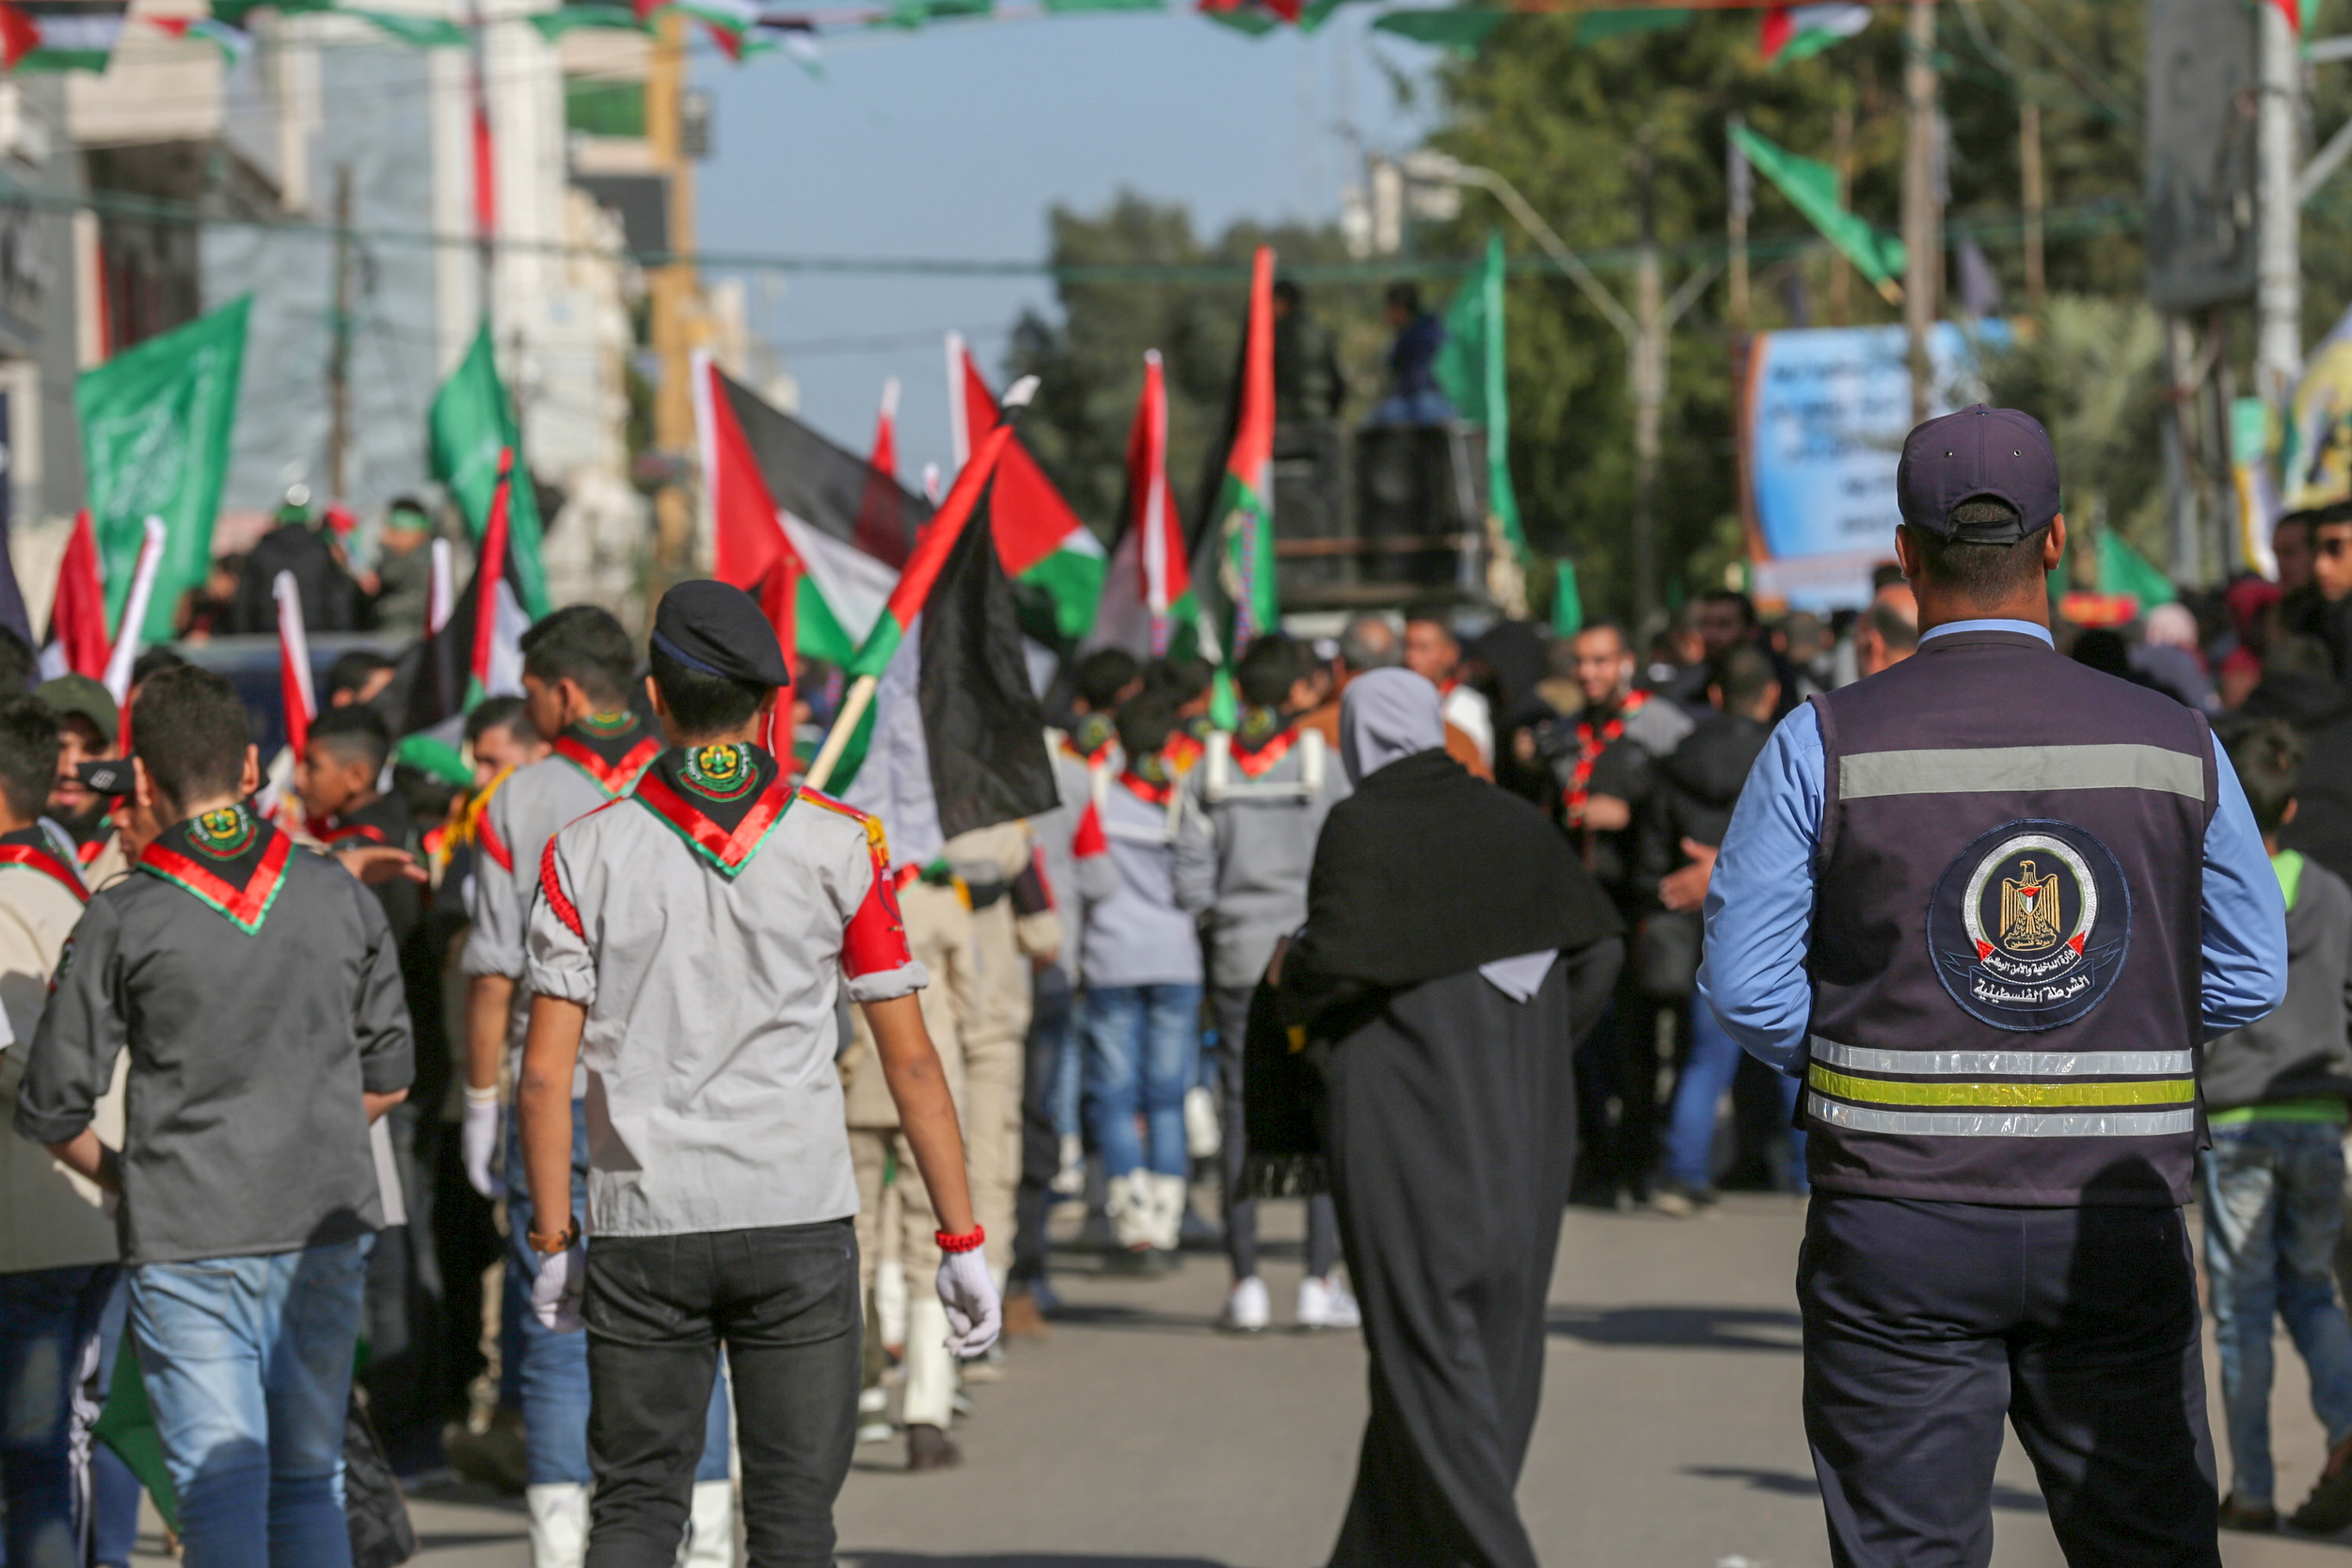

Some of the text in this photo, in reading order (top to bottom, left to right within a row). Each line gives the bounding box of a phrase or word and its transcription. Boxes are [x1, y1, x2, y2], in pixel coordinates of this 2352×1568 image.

[2058, 949, 2076, 964] وزارة
[2032, 959, 2061, 976] الداخلية
[1973, 974, 2090, 1004] الشرطة الفلسطينية
